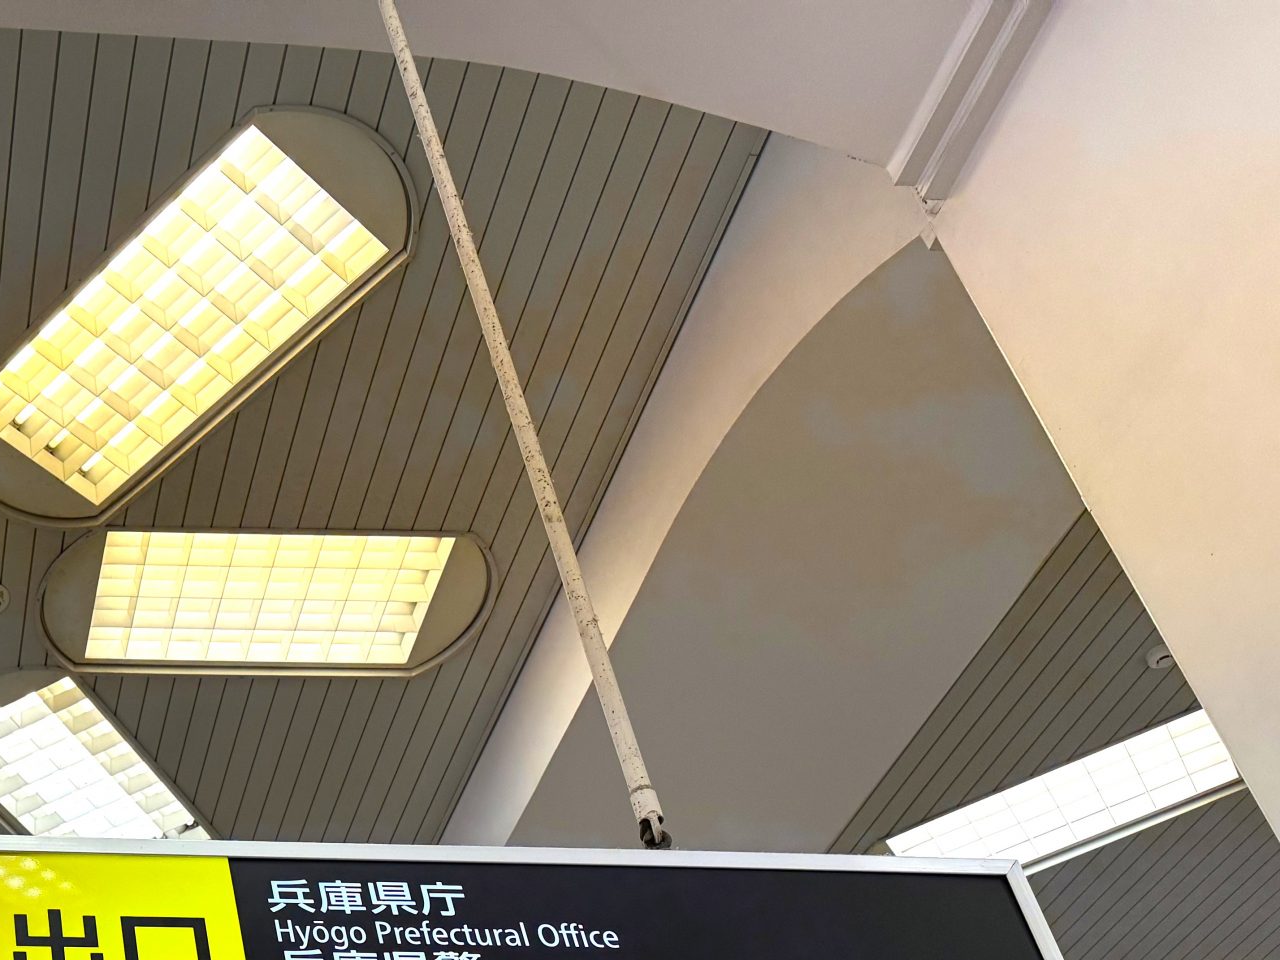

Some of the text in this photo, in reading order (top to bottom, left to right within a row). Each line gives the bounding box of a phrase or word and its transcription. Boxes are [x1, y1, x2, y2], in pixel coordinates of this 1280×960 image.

[268, 880, 465, 916] 兵庫県庁
[275, 920, 619, 950] Hyōgo Prefectural Office
